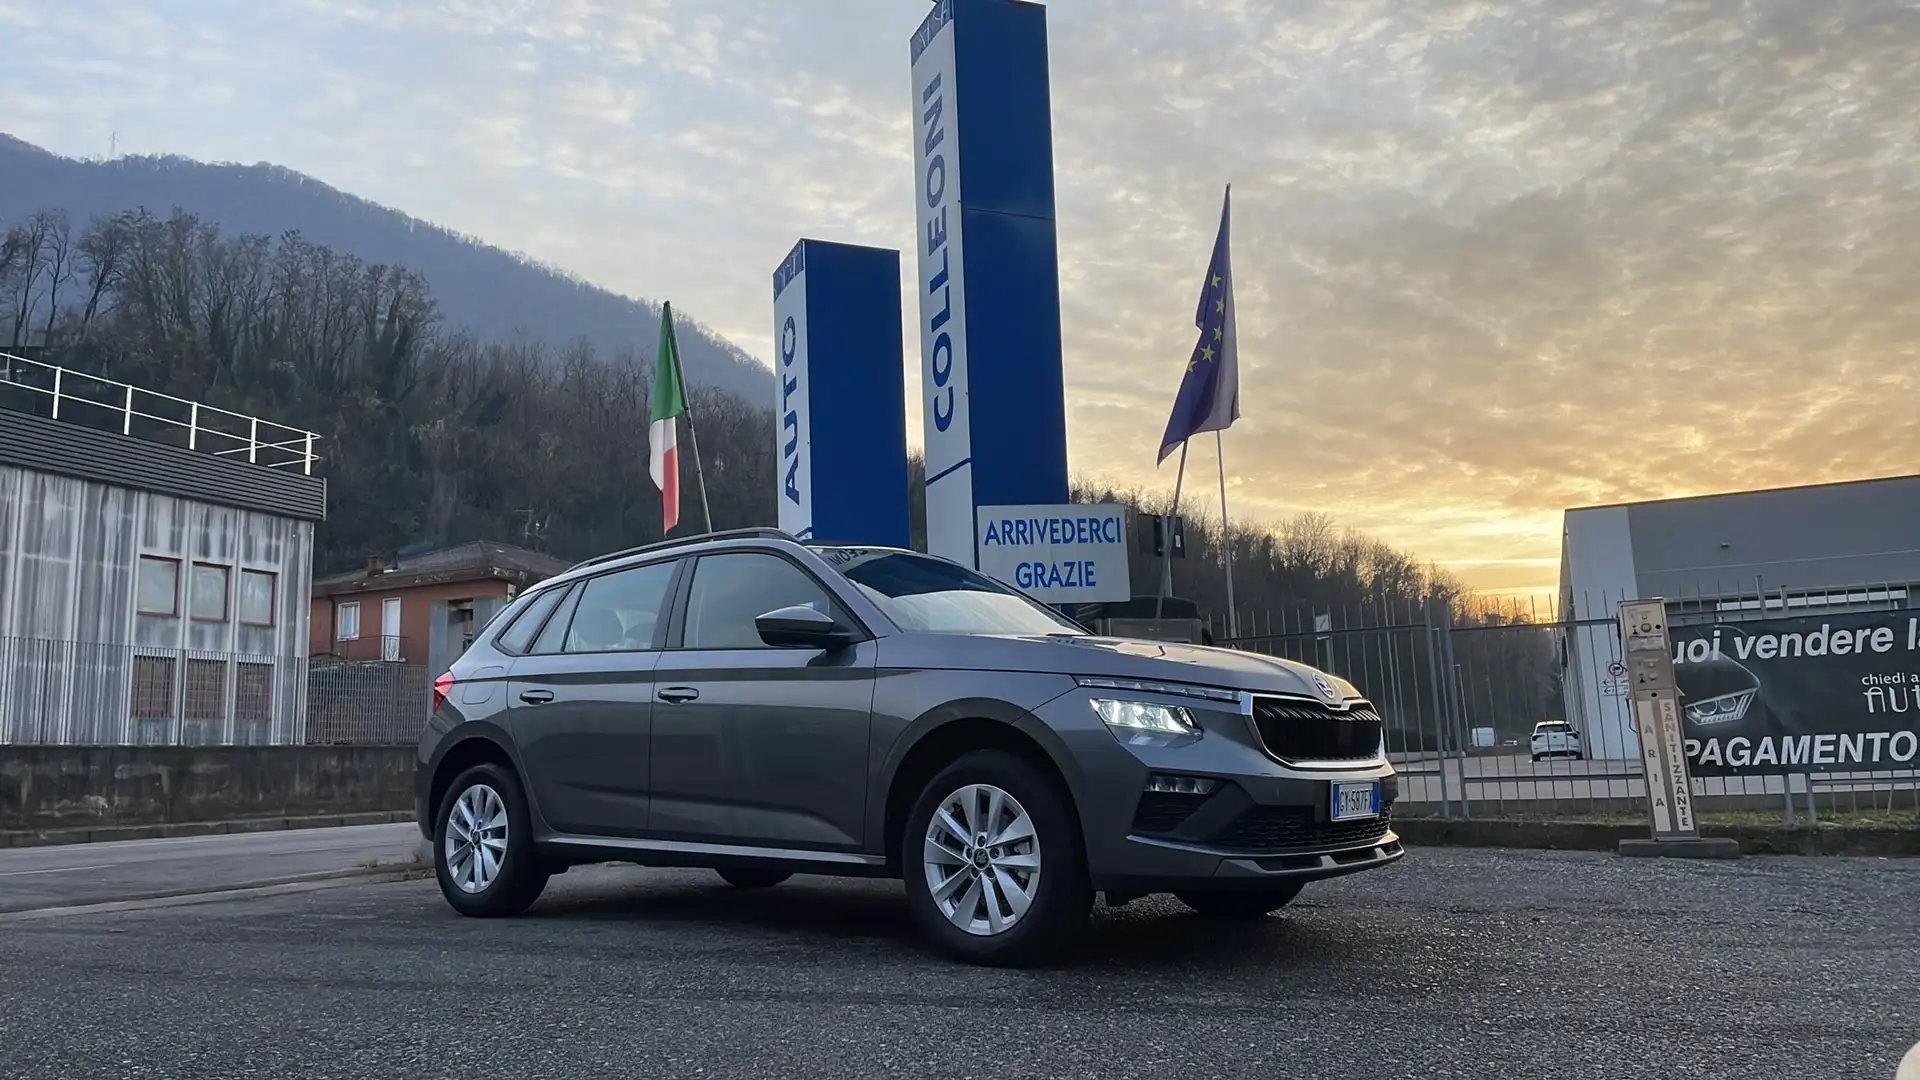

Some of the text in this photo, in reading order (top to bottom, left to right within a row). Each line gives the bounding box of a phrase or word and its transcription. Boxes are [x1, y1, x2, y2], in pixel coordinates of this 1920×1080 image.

[923, 72, 954, 432] COLLEONI
[782, 315, 800, 506] AUTO
[984, 517, 1121, 546] ARRIVEDERCI
[1015, 560, 1097, 588] GRAZIE
[1670, 617, 1920, 665] uoi vendere l
[1861, 671, 1906, 686] chiedi
[1644, 724, 1665, 808] ARIA
[1664, 701, 1689, 827] SANITIZZANTE
[1684, 730, 1918, 767] PAGAMENTO
